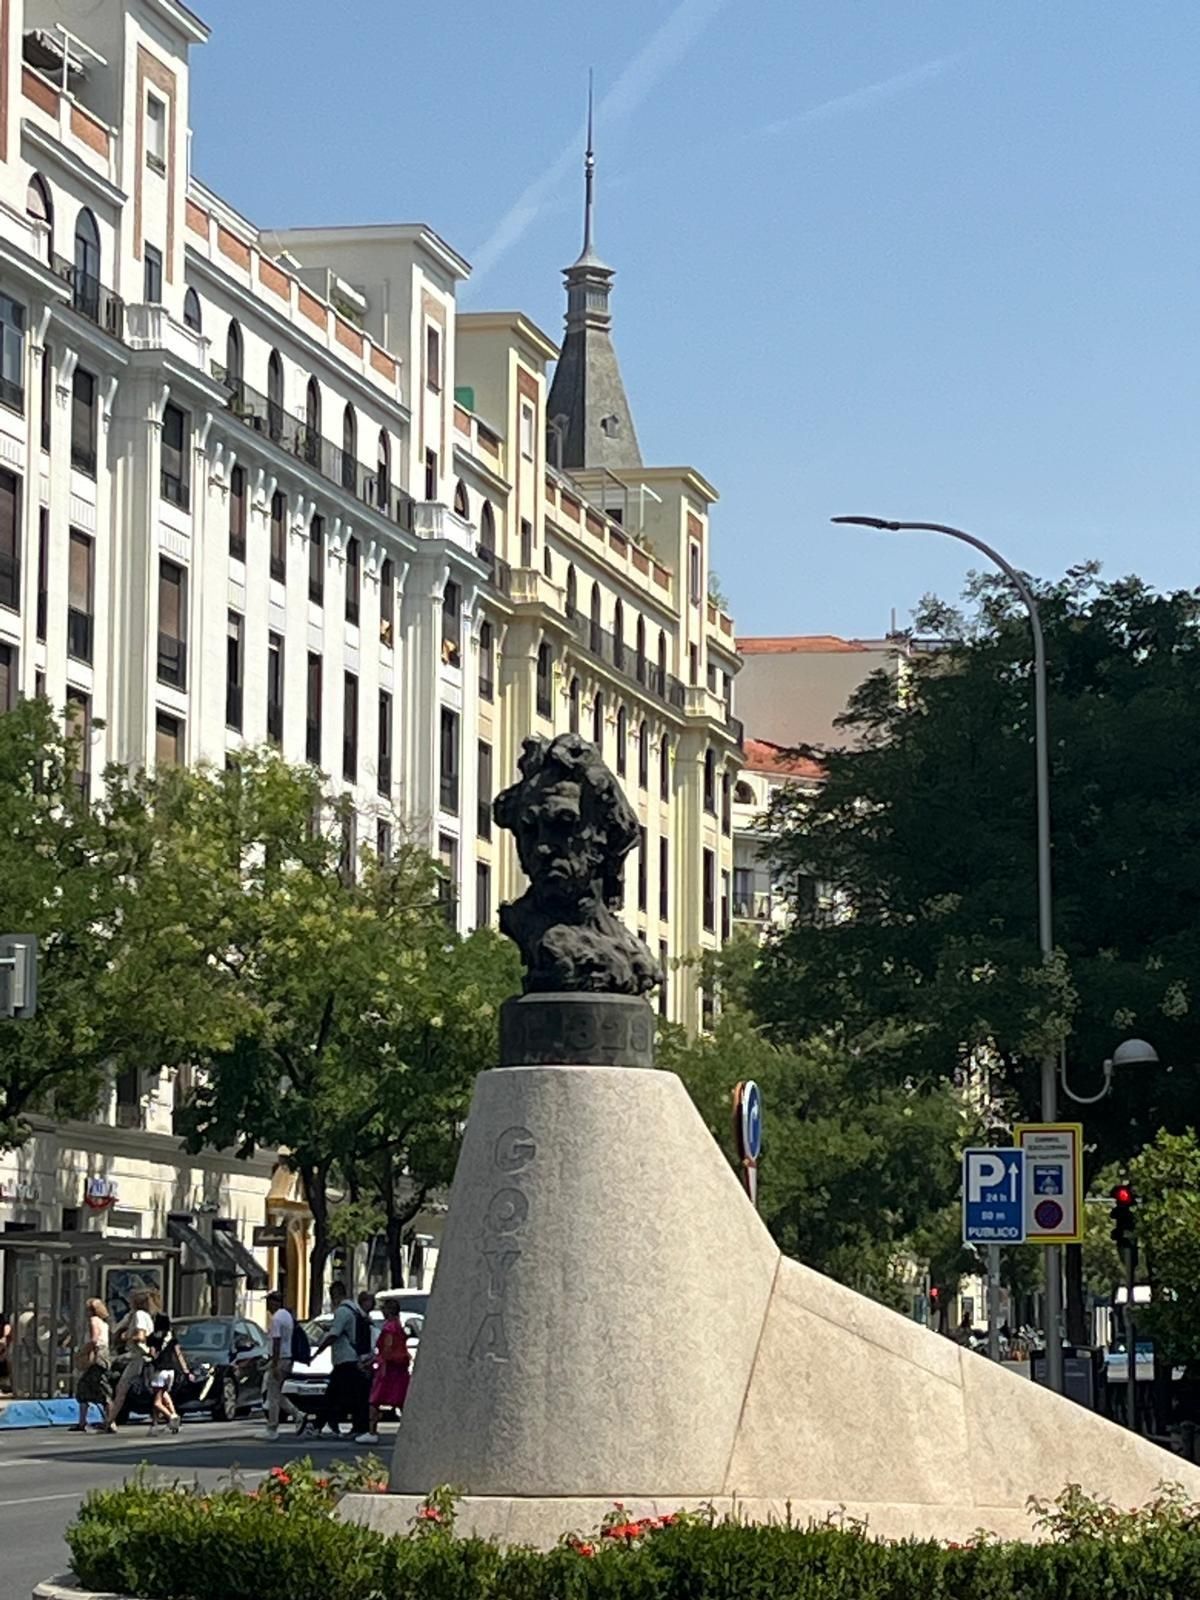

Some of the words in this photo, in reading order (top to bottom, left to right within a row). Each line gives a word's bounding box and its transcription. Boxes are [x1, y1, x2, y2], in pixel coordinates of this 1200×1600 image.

[968, 1154, 1006, 1203] P
[995, 1212, 1006, 1220] m
[467, 1126, 537, 1363] GOYA
